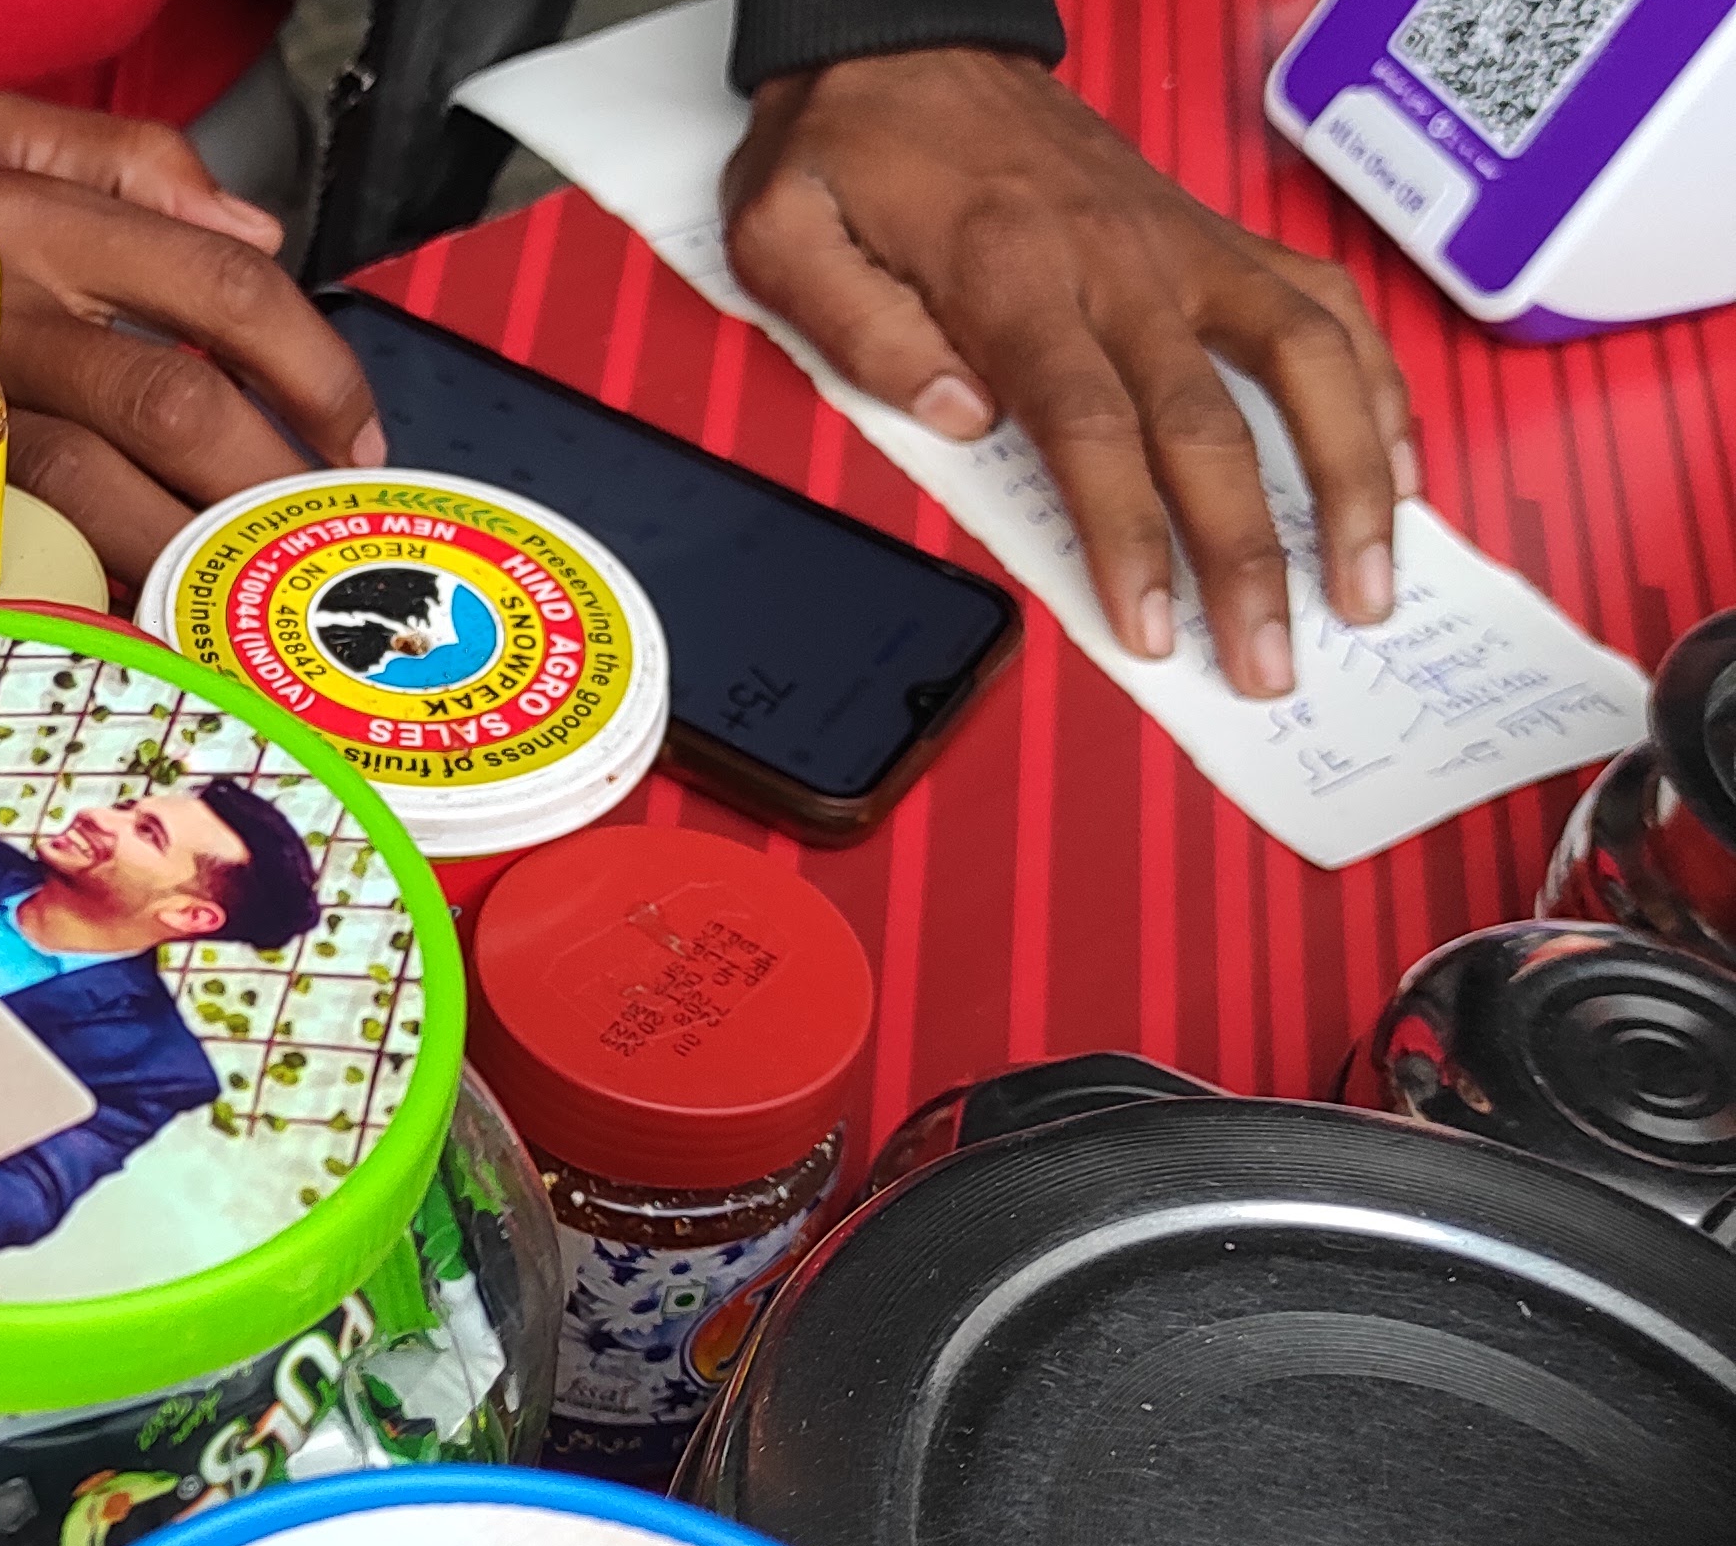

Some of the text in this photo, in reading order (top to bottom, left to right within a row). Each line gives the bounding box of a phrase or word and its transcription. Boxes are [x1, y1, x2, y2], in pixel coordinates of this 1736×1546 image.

[189, 493, 360, 665] Frootful Happiness
[326, 542, 427, 563] REGD.
[381, 514, 457, 542] NEW
[235, 631, 317, 712] (INDIA)
[273, 603, 327, 682] 468842
[344, 532, 620, 779] Preserving the goodness of fruits
[367, 554, 582, 748] HIND AGRO SALES
[426, 595, 536, 718] SNOWPEAK
